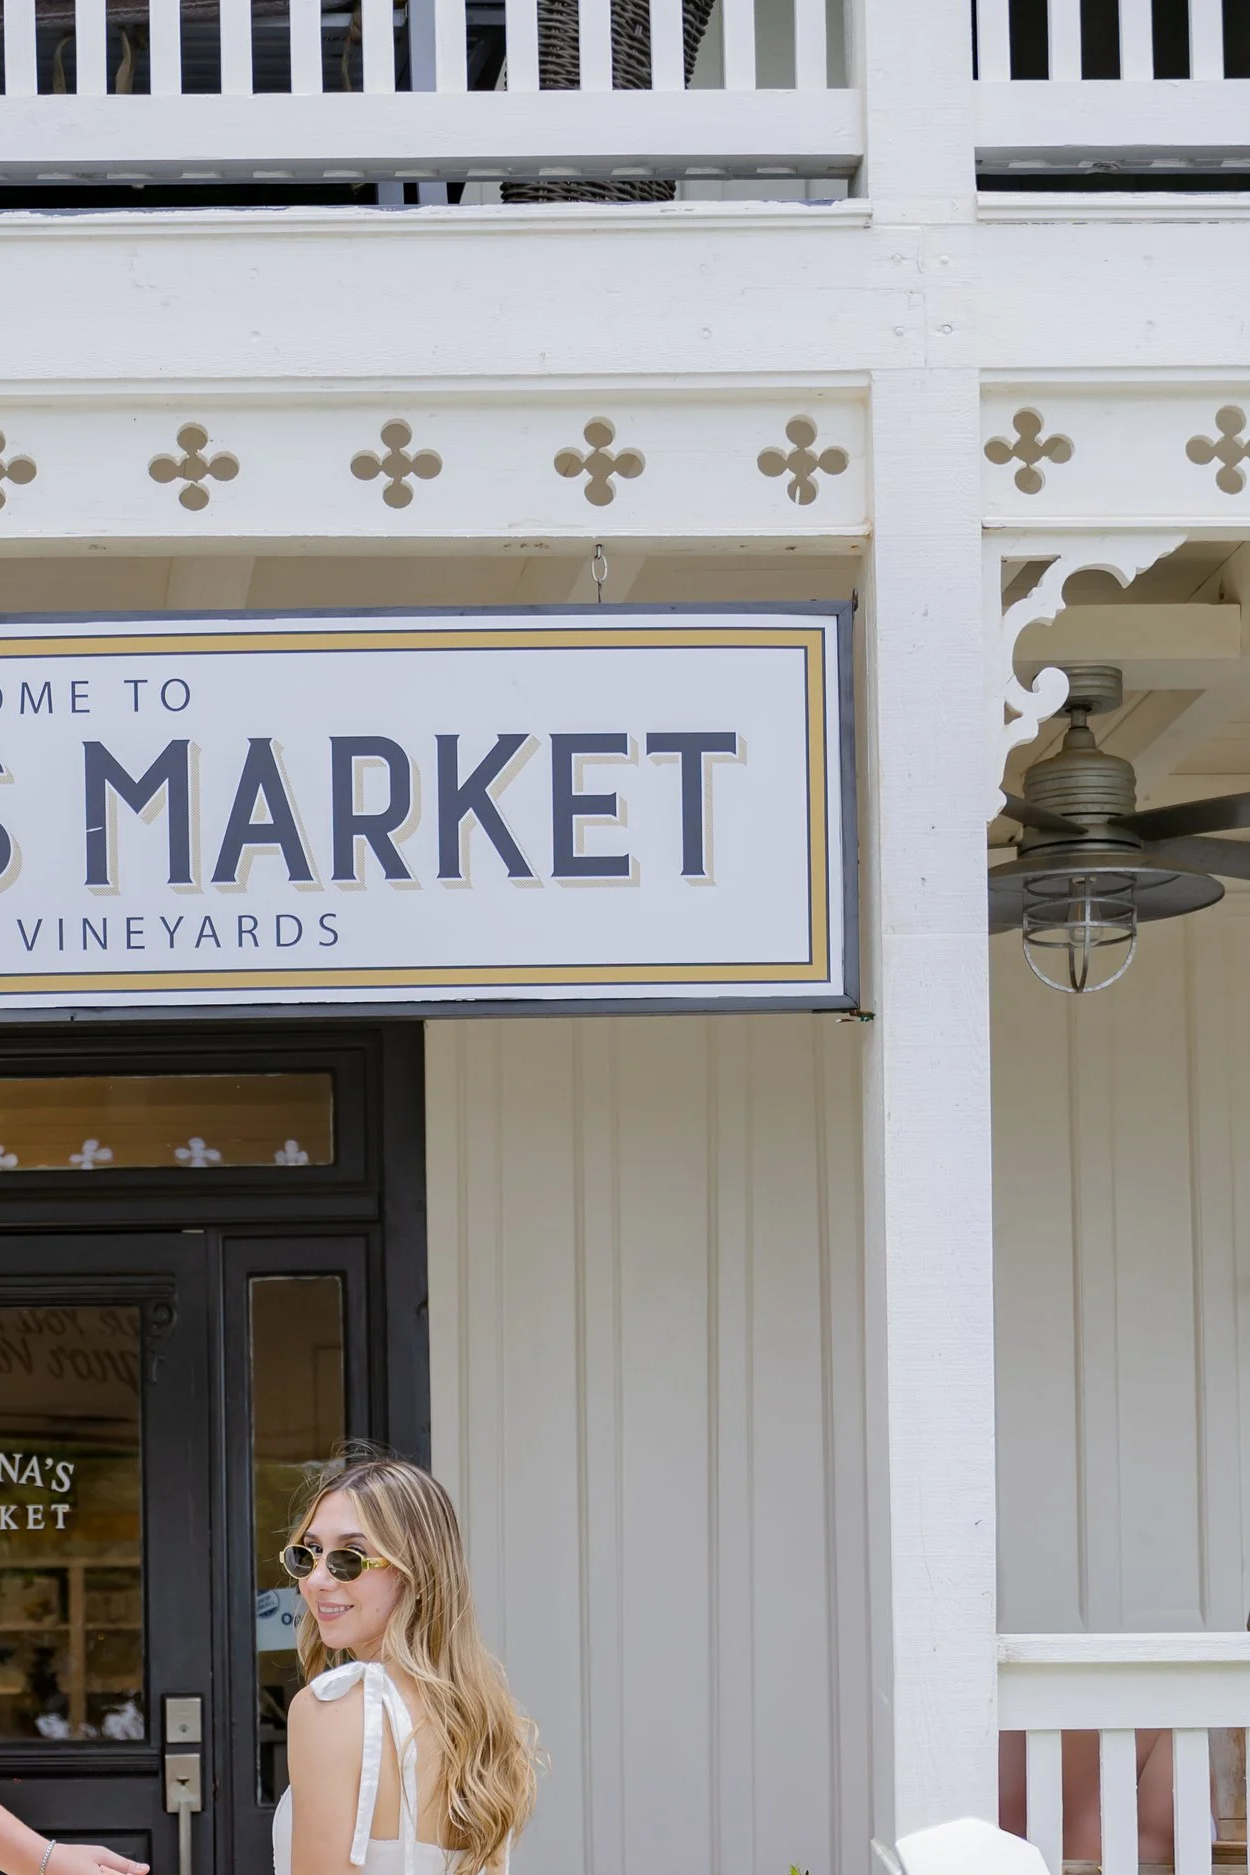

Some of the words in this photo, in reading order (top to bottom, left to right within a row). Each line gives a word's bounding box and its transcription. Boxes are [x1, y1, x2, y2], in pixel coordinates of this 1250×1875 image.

[123, 678, 191, 713] TO
[82, 731, 742, 889] MARKET
[16, 913, 340, 952] VINEYARDS
